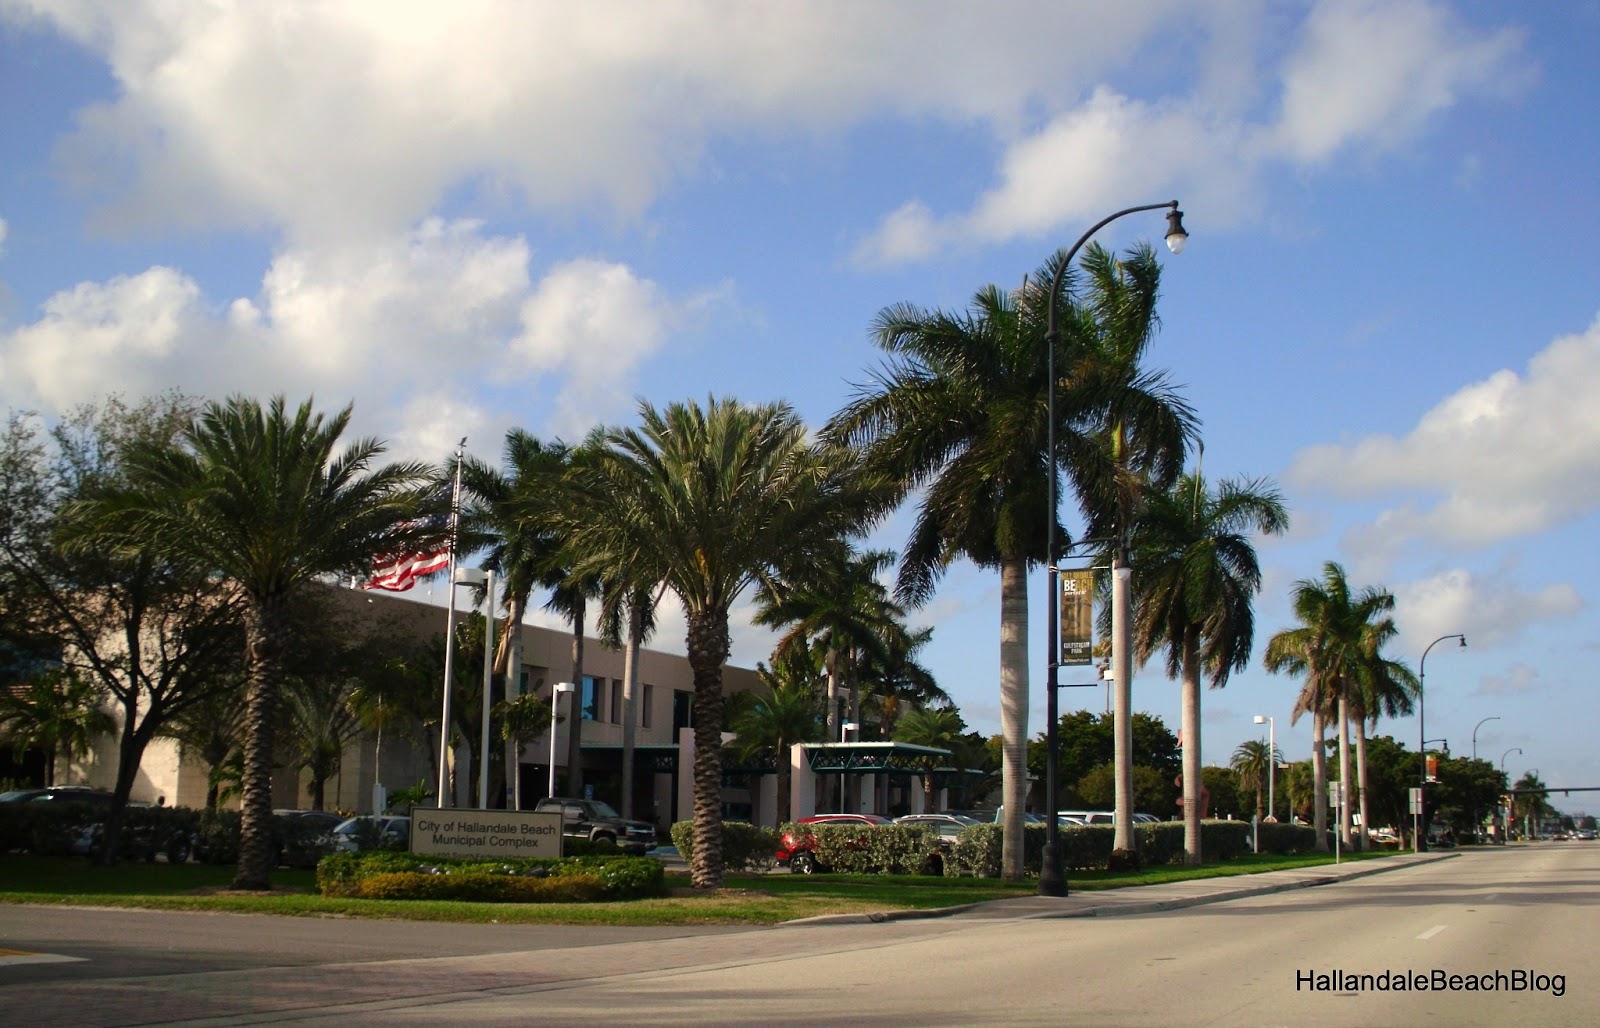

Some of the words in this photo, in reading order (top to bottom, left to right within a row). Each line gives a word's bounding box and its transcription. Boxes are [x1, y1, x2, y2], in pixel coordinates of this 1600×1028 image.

[1064, 579, 1093, 592] BEACH
[418, 820, 441, 833] City
[443, 822, 455, 832] of
[457, 822, 517, 834] Hallandale
[521, 824, 556, 835] Beach
[432, 834, 486, 847] Municipal
[489, 835, 538, 849] Complex
